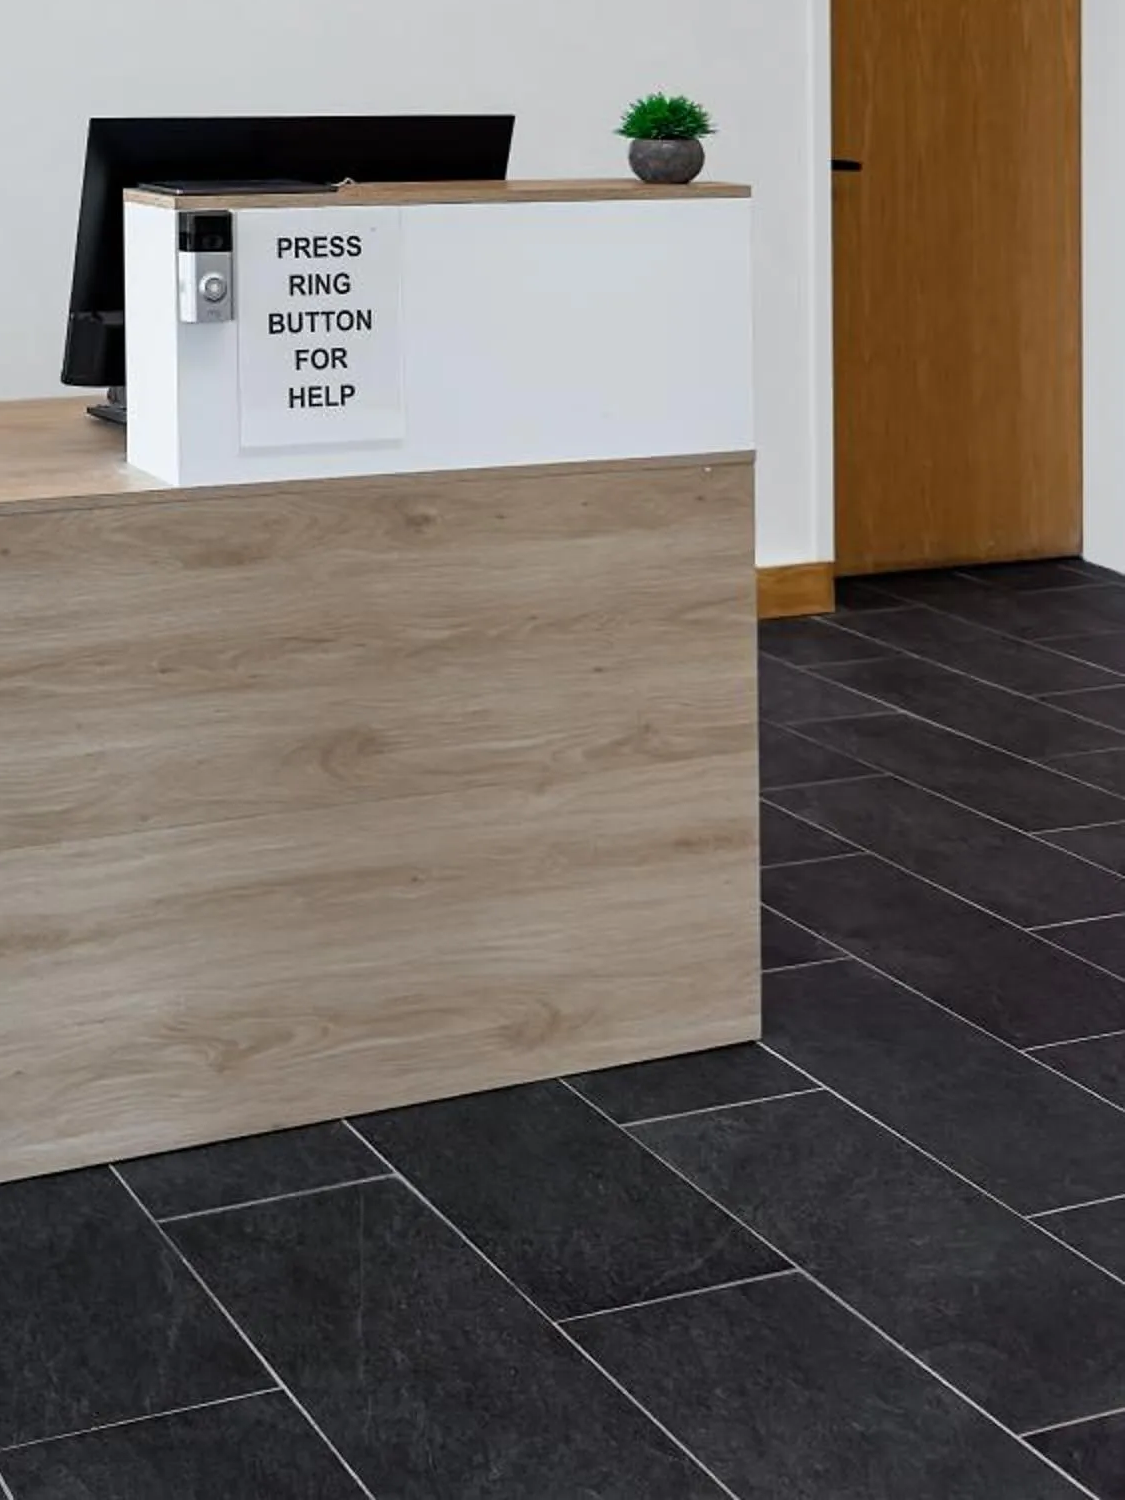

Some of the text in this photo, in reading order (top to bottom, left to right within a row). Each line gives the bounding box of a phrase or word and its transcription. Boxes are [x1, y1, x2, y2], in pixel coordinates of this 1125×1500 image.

[277, 235, 362, 259] PRESS
[289, 272, 351, 296] RING
[268, 309, 372, 335] BUTTON
[295, 347, 348, 371] FOR
[288, 384, 356, 409] HELP
